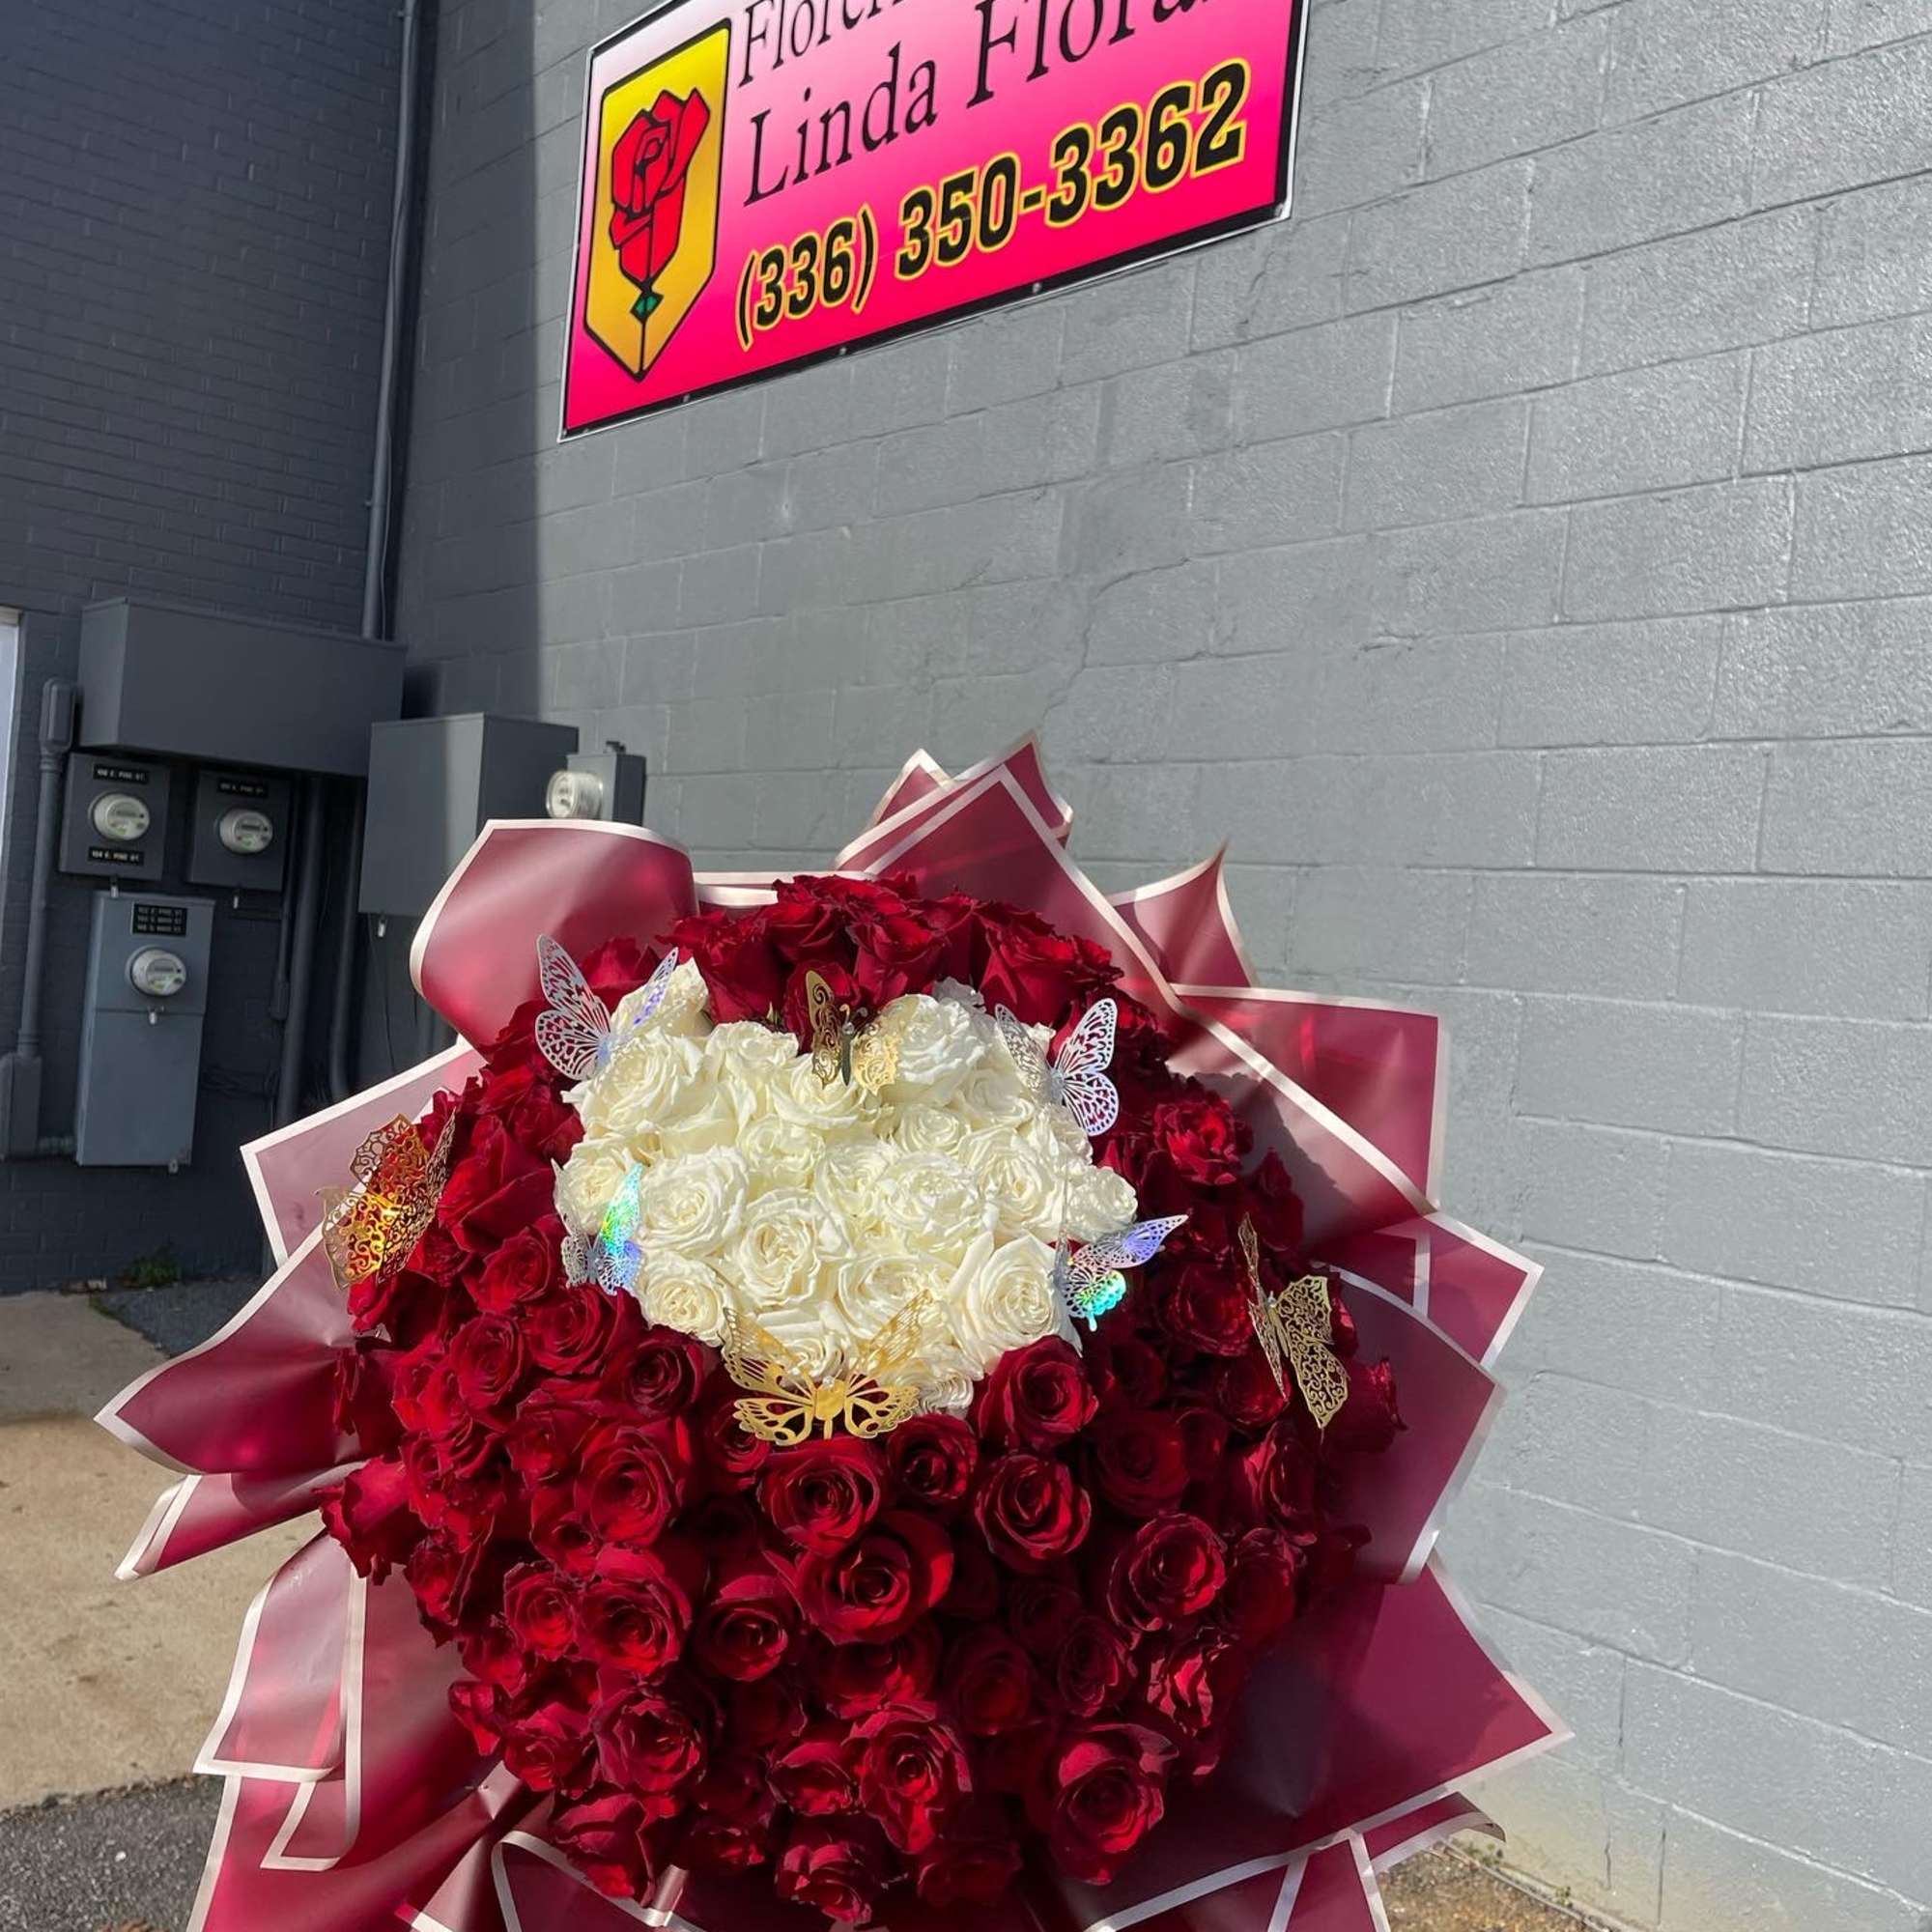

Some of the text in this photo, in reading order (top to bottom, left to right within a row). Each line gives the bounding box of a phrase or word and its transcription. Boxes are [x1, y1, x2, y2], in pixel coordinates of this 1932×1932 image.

[736, 57, 1251, 352] (336) 350-3362
[743, 0, 1208, 207] Linda Flor
